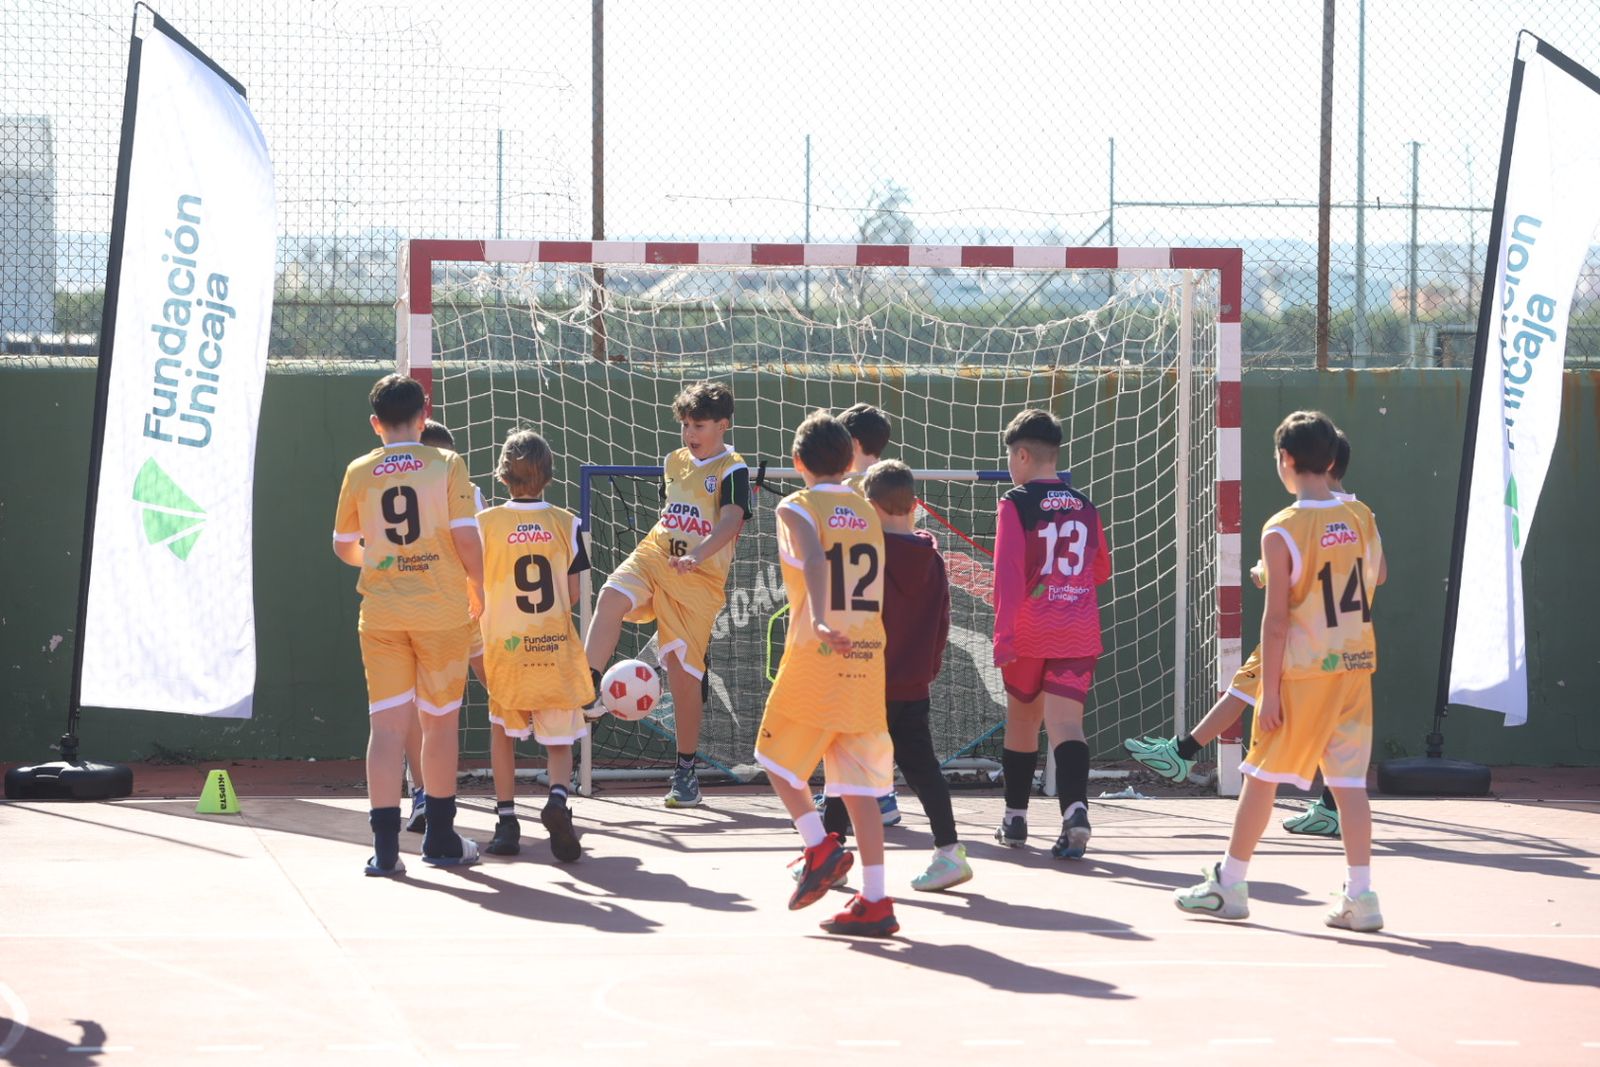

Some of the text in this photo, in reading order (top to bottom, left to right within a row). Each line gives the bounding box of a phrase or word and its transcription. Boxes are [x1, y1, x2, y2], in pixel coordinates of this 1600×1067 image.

[143, 193, 202, 443] Fundación
[177, 271, 237, 449] Unicaja
[385, 453, 412, 463] COPA
[373, 460, 423, 476] COVAP
[1041, 498, 1083, 511] COVAP
[381, 485, 420, 546] 9
[517, 523, 541, 532] COPA
[507, 532, 552, 544] COVAP
[669, 538, 688, 557] 16
[1038, 520, 1088, 576] 13
[397, 552, 440, 564] Fundación
[397, 562, 430, 573] Unicaja
[514, 554, 555, 614] 9
[825, 542, 880, 612] 12
[1318, 557, 1371, 628] 14
[524, 642, 559, 653] Unicaja
